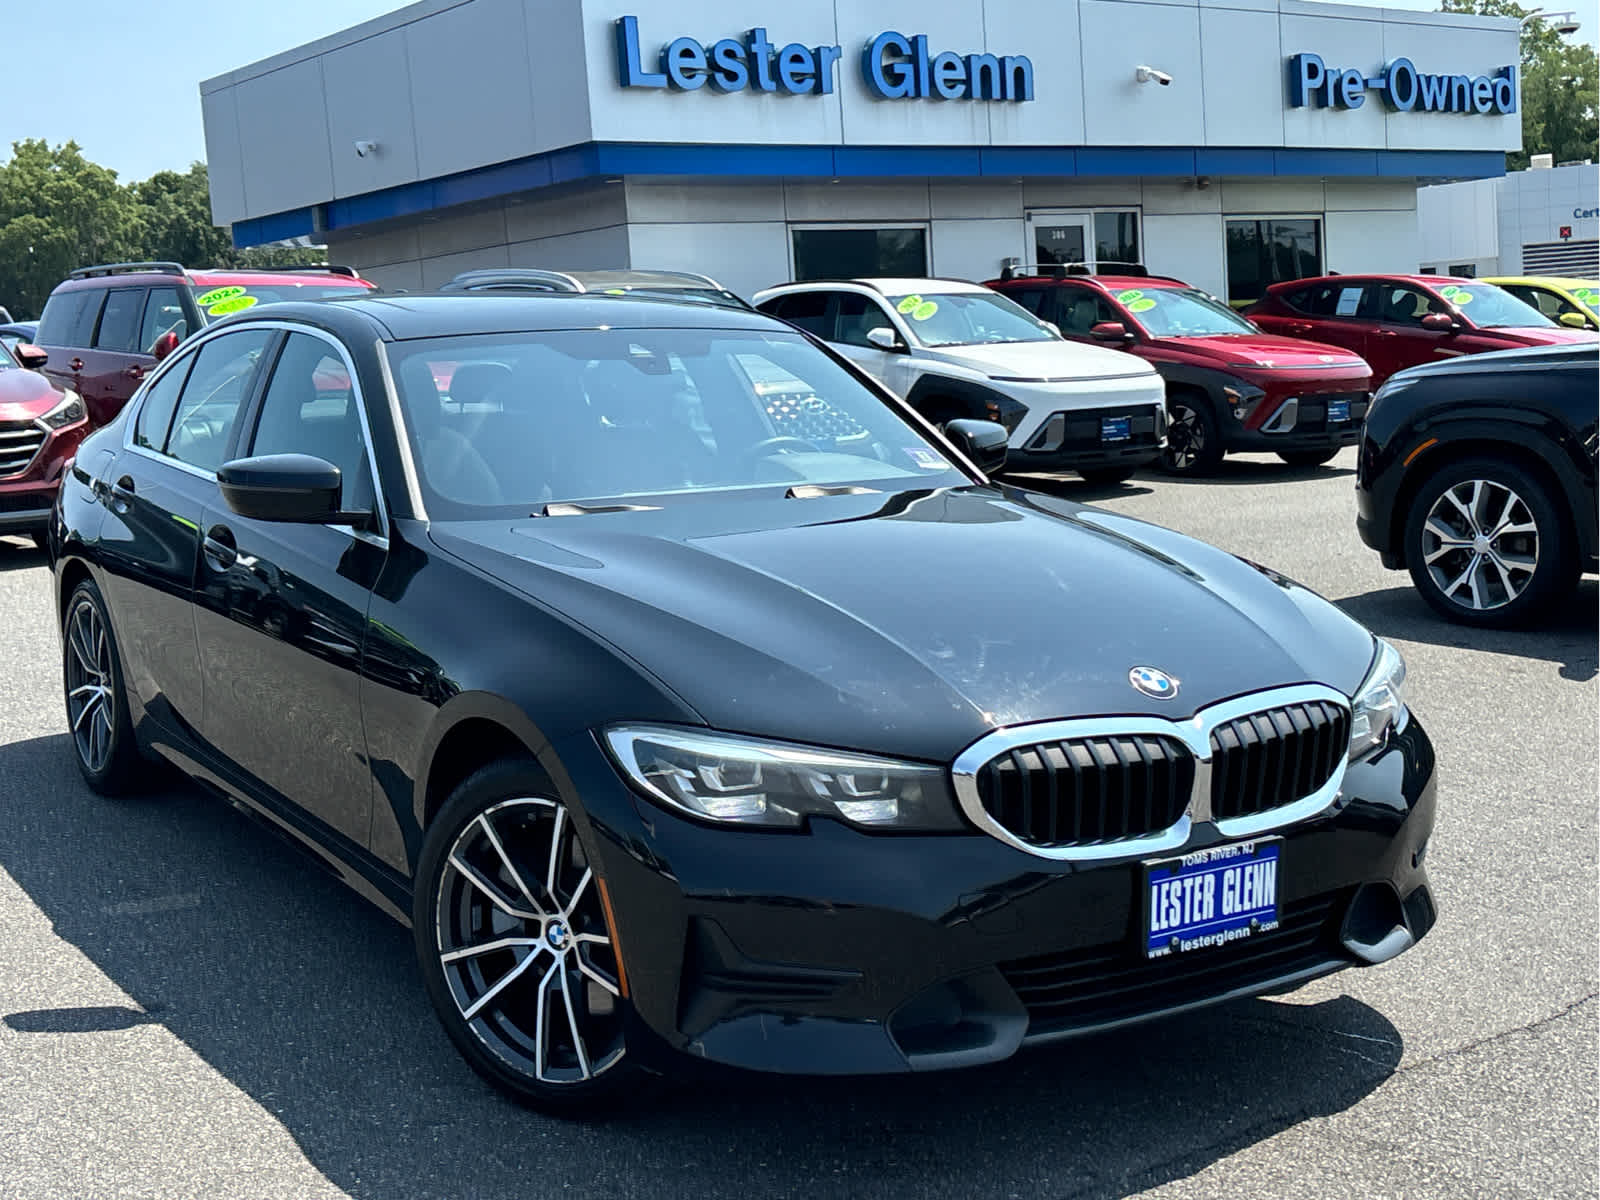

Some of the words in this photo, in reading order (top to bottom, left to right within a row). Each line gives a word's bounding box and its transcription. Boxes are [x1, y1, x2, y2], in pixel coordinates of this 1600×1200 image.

[616, 15, 841, 95] Lester
[863, 31, 1035, 102] Glenn
[1290, 53, 1517, 114] Pre-Owned
[203, 287, 242, 303] 2024
[1181, 852, 1209, 867] TOMS
[1242, 843, 1255, 854] NJ
[1151, 873, 1215, 932] LESTER
[1222, 860, 1277, 915] GLENN
[1180, 927, 1250, 952] lesterglenn
